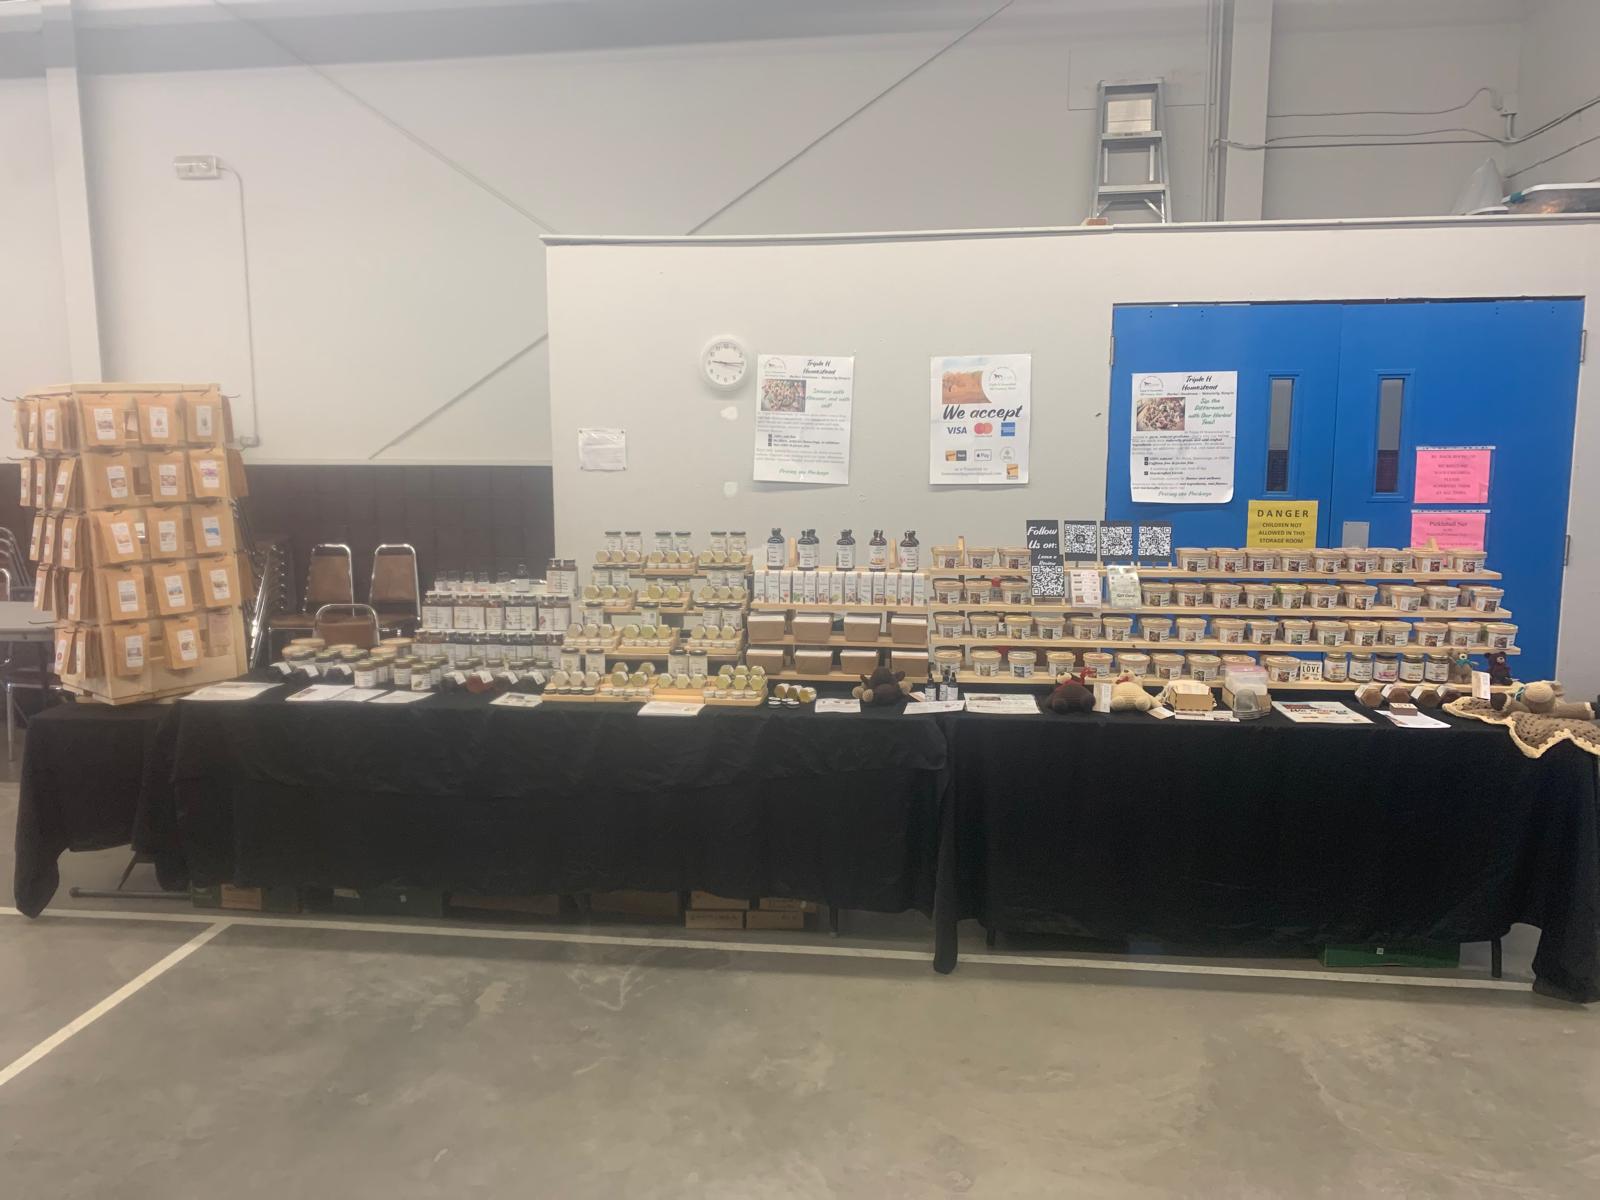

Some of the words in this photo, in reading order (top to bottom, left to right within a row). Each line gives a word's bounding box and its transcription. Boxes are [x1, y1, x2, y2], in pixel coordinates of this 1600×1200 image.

[1186, 375, 1205, 383] Triple
[943, 404, 965, 420] We
[970, 405, 1023, 421] accept
[947, 426, 967, 434] VISA
[1257, 509, 1309, 518] DANGER
[1027, 525, 1058, 536] Follow
[1028, 539, 1040, 549] Us
[1043, 541, 1058, 549] on:
[1302, 665, 1320, 673] LOVE
